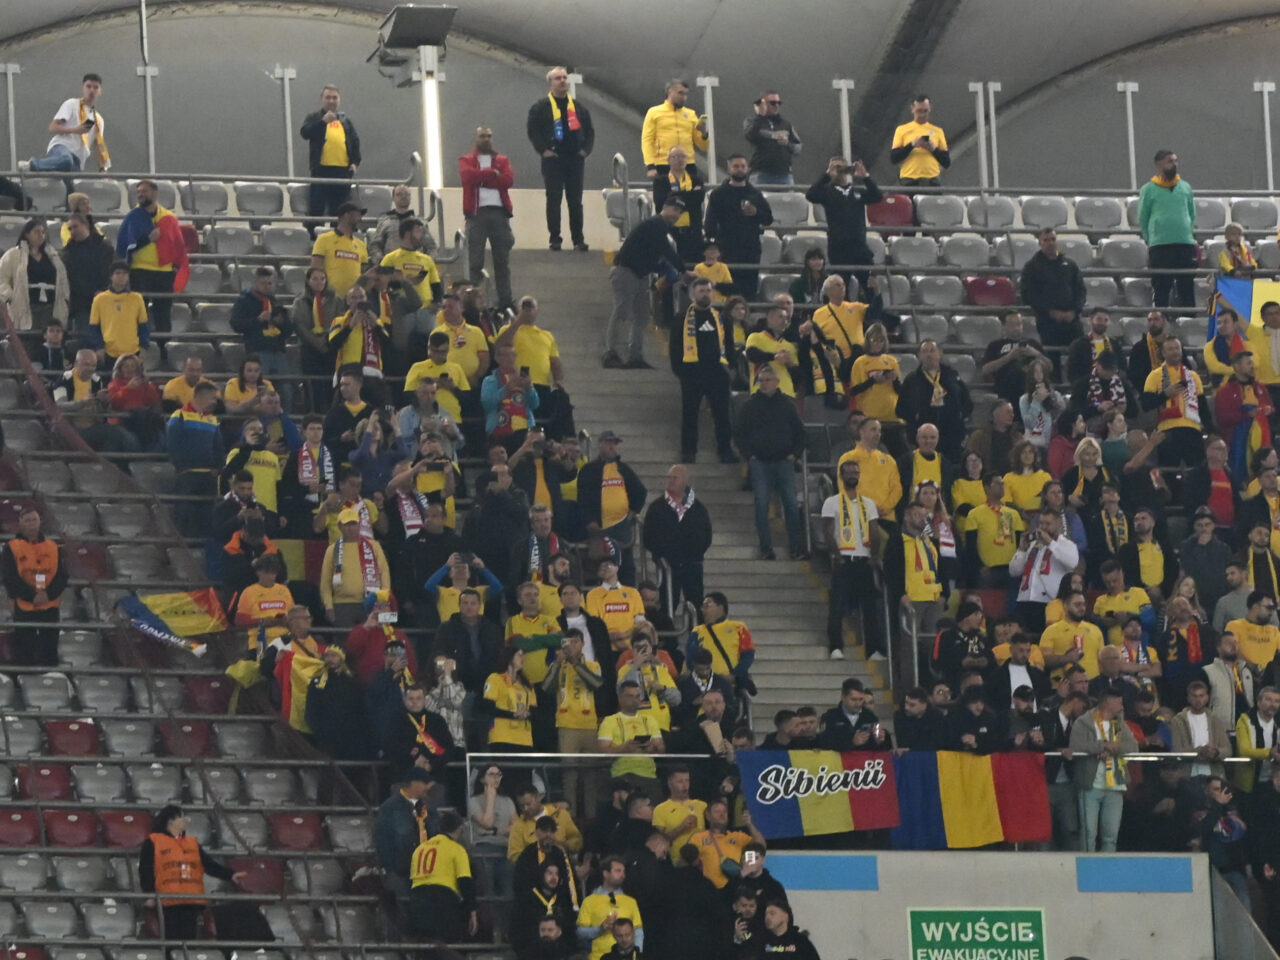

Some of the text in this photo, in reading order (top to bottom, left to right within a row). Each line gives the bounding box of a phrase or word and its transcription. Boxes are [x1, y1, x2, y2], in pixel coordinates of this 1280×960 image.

[756, 759, 888, 806] Sibienii
[417, 849, 437, 876] 10
[922, 916, 1034, 943] WYJŚCIE
